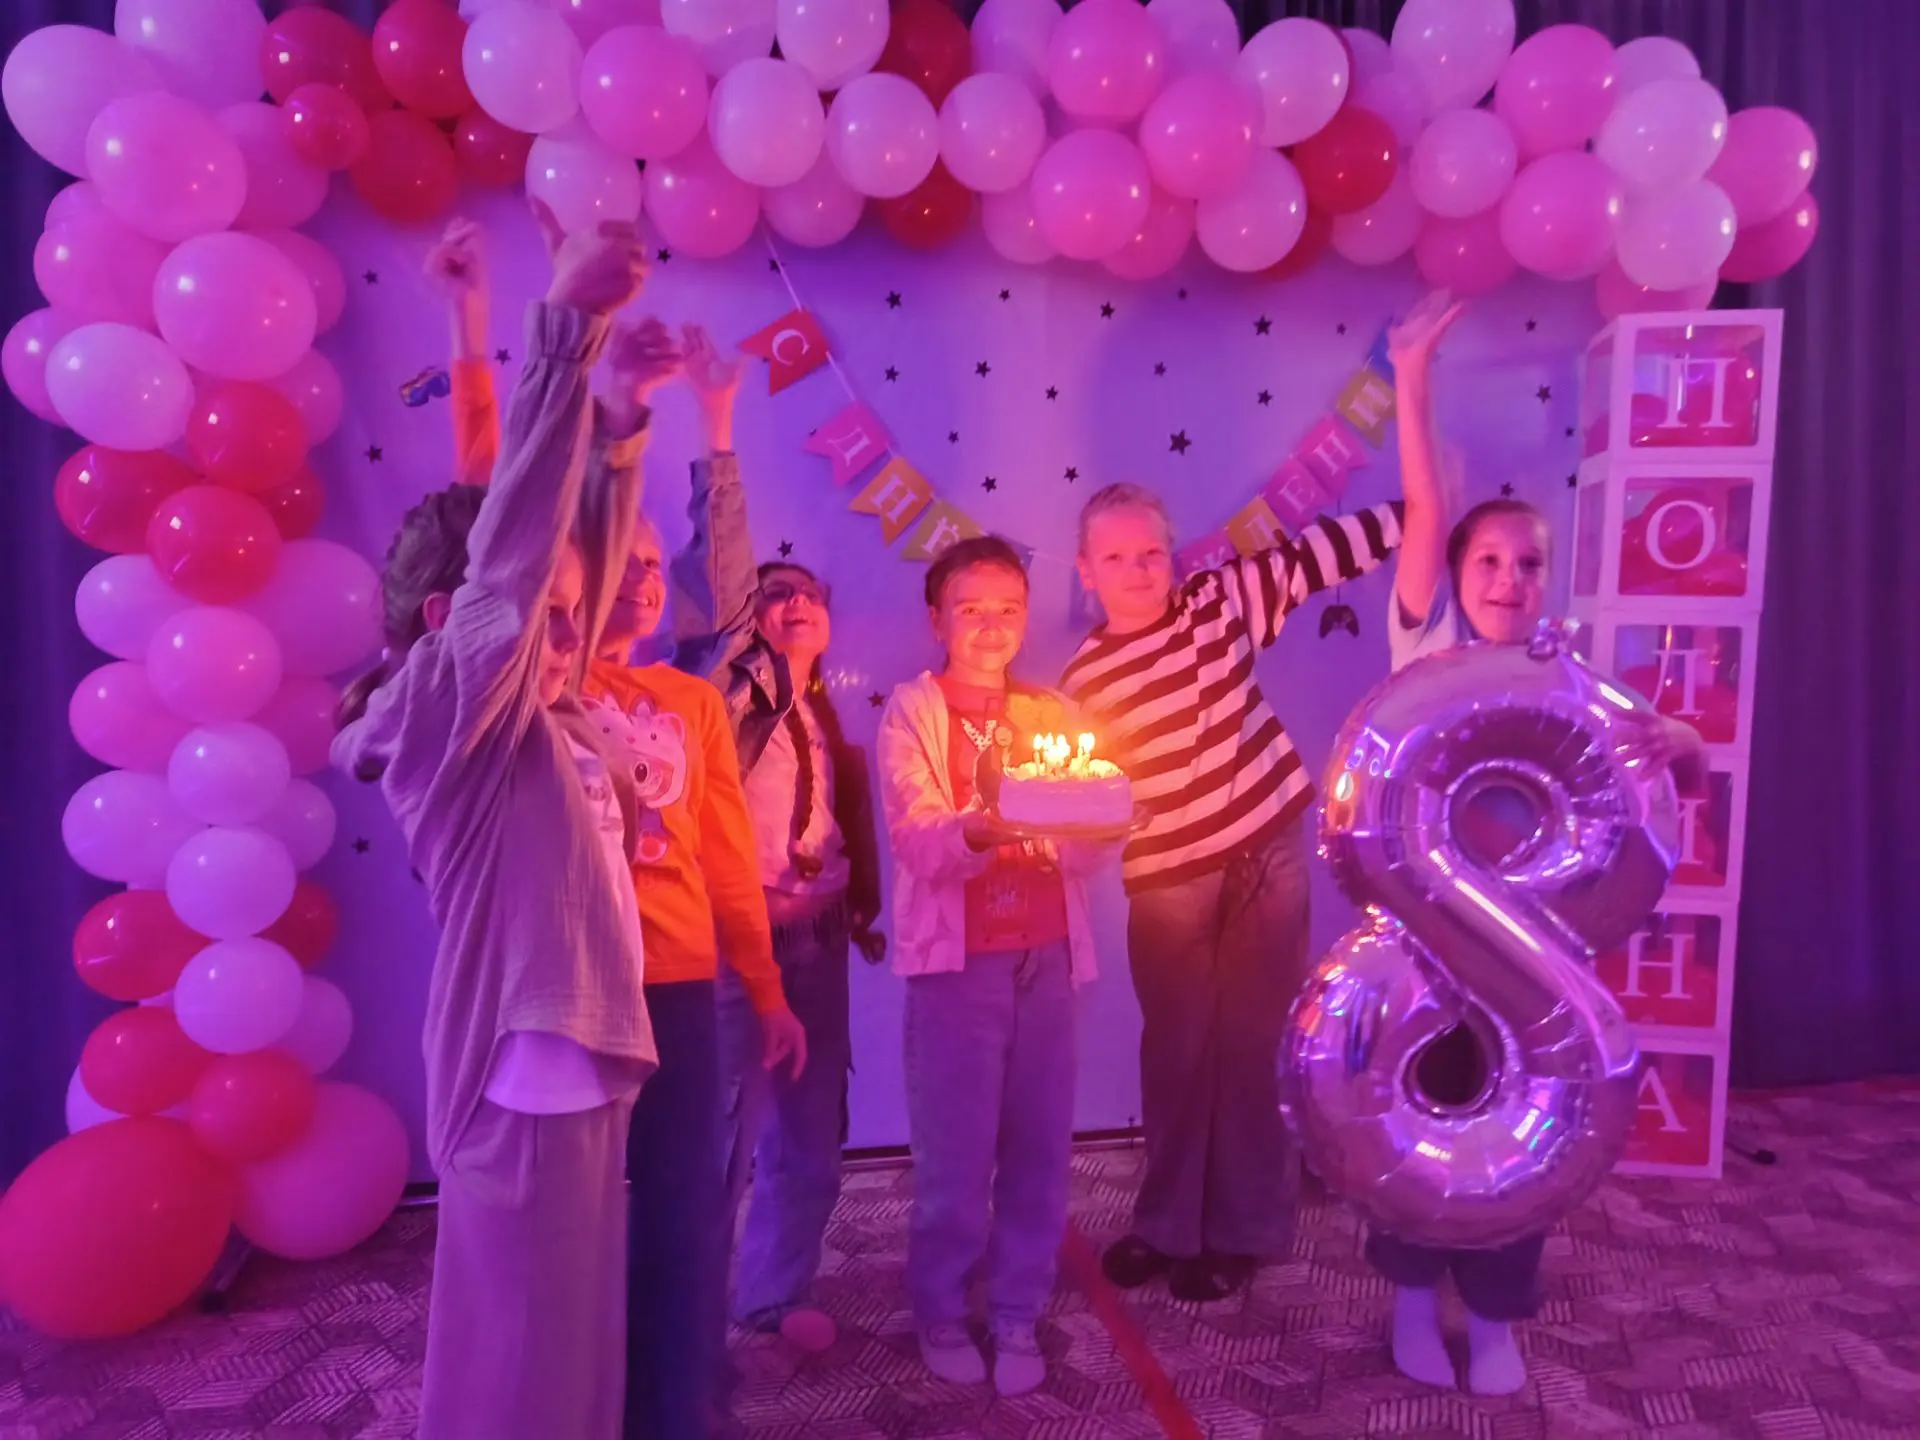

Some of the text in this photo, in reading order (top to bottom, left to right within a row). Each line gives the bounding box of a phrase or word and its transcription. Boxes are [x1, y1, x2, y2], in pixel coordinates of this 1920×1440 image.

[771, 328, 811, 366] С
[826, 425, 962, 554] ДНЁ
[1276, 622, 1680, 1248] 8
